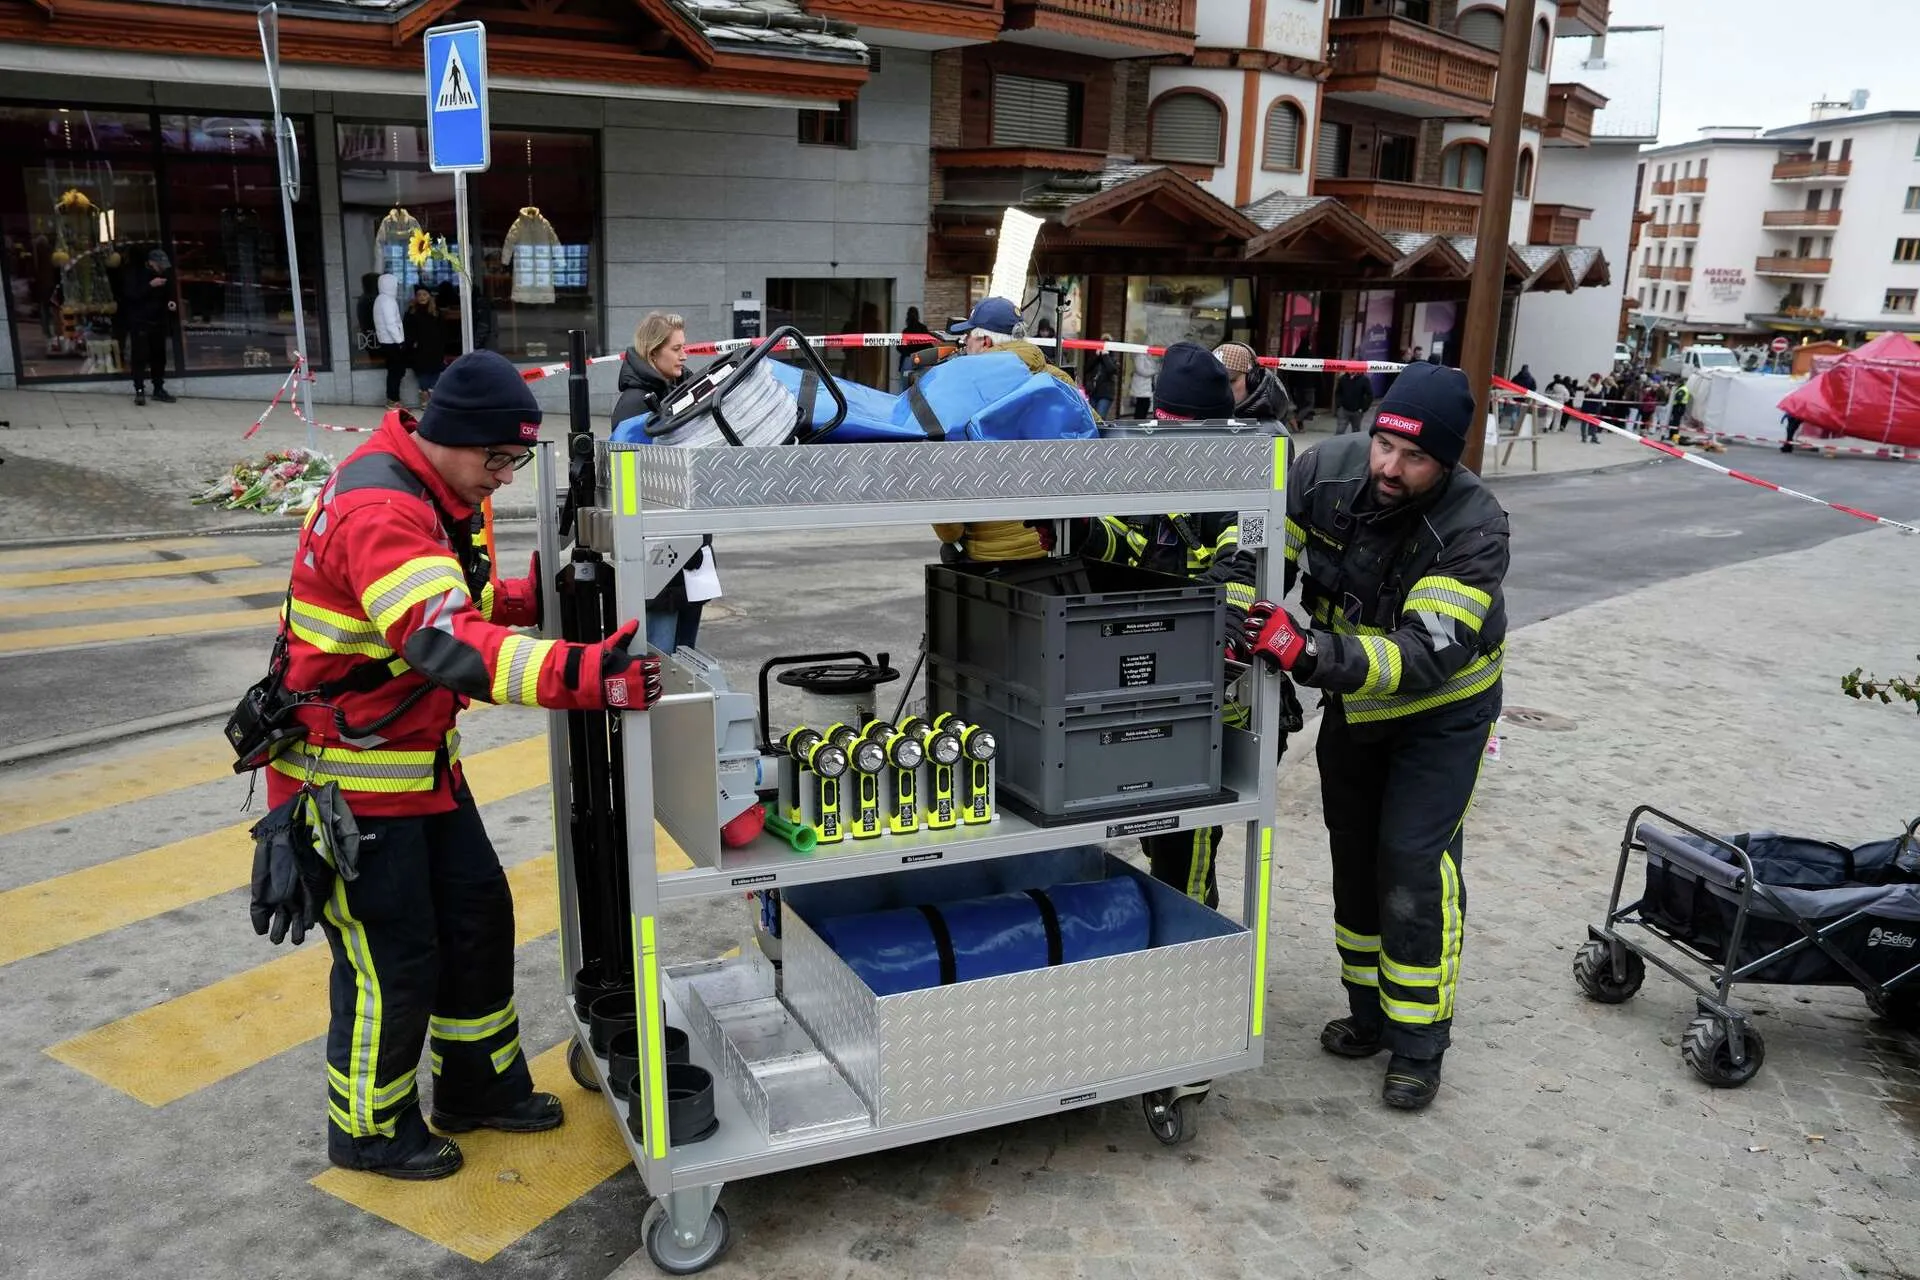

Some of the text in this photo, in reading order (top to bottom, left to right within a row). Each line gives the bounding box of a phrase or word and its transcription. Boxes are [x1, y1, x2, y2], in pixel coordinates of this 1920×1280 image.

[1703, 268, 1742, 277] AGENCE
[865, 338, 885, 346] POLICE
[1882, 931, 1917, 947] Sekey
